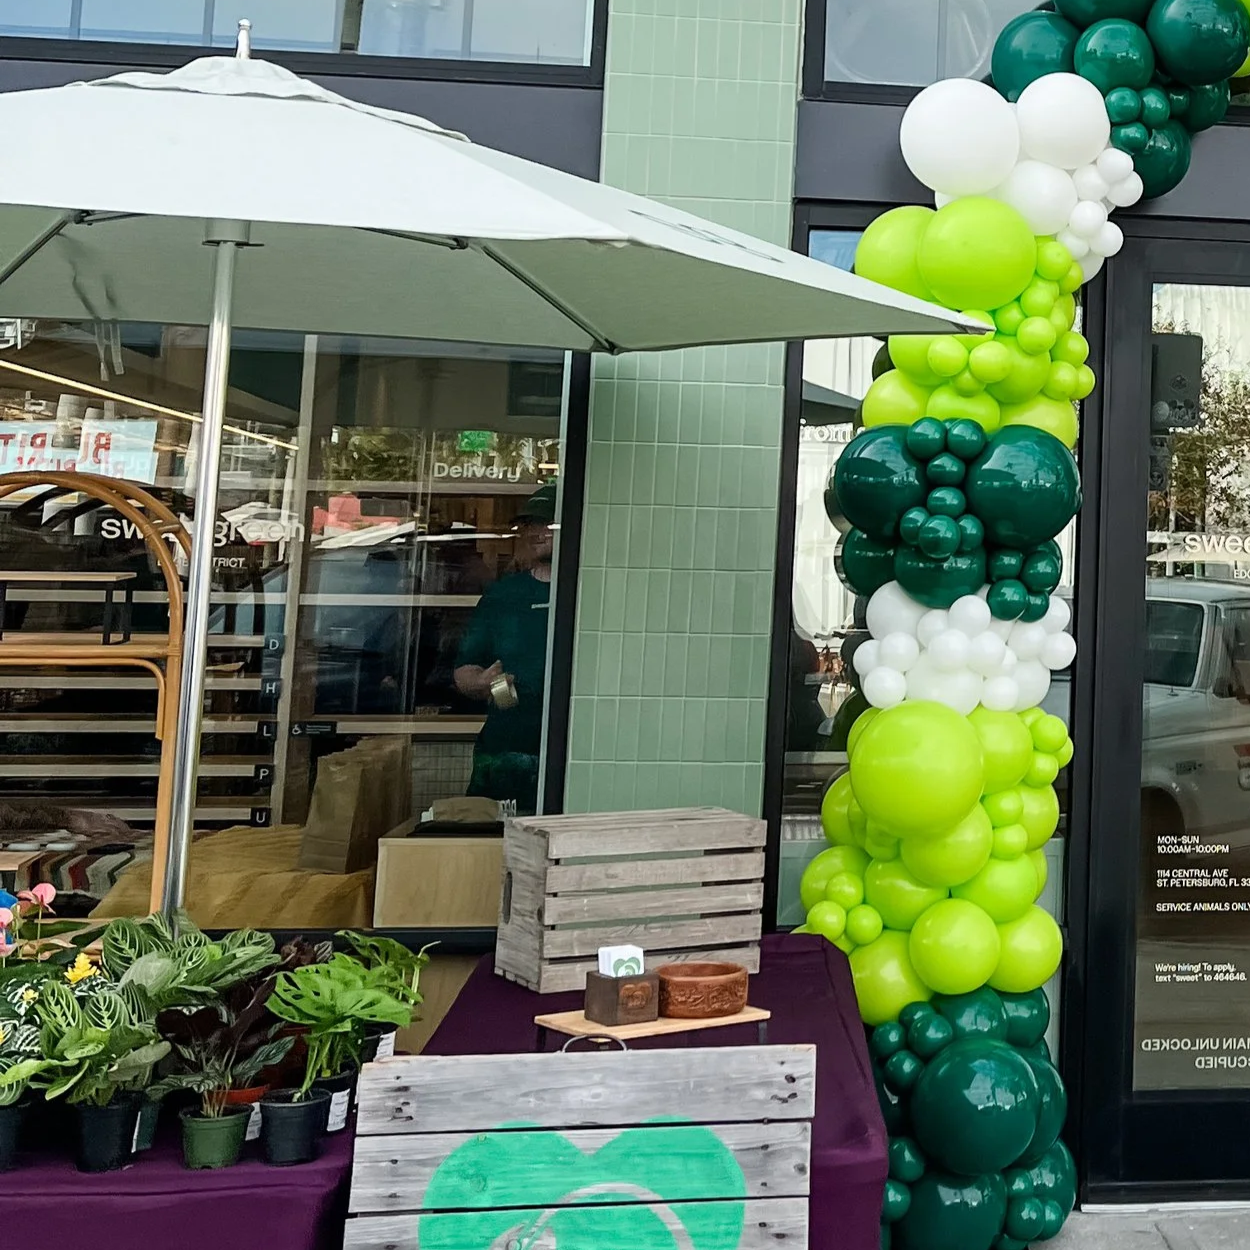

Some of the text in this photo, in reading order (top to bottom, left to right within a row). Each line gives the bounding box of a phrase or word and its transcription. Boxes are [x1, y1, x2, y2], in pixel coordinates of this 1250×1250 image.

[433, 462, 521, 482] Delivery
[101, 518, 304, 547] swgreen
[269, 639, 279, 650] D
[265, 682, 276, 694] H
[263, 725, 271, 736] L
[259, 768, 269, 779] P
[256, 811, 266, 823] U
[1157, 836, 1199, 844] MON-SUN
[1157, 869, 1228, 878] 1114 CENTRAL AVE
[1156, 879, 1169, 887] ST.
[1170, 879, 1228, 888] PETERSBURG,
[1229, 878, 1239, 886] FL
[1156, 903, 1191, 911] SERVICE
[1193, 903, 1230, 911] ANIMALS
[1177, 963, 1201, 973] hiring!
[1202, 963, 1212, 971] To
[1155, 974, 1171, 982] text
[1203, 973, 1212, 981] to
